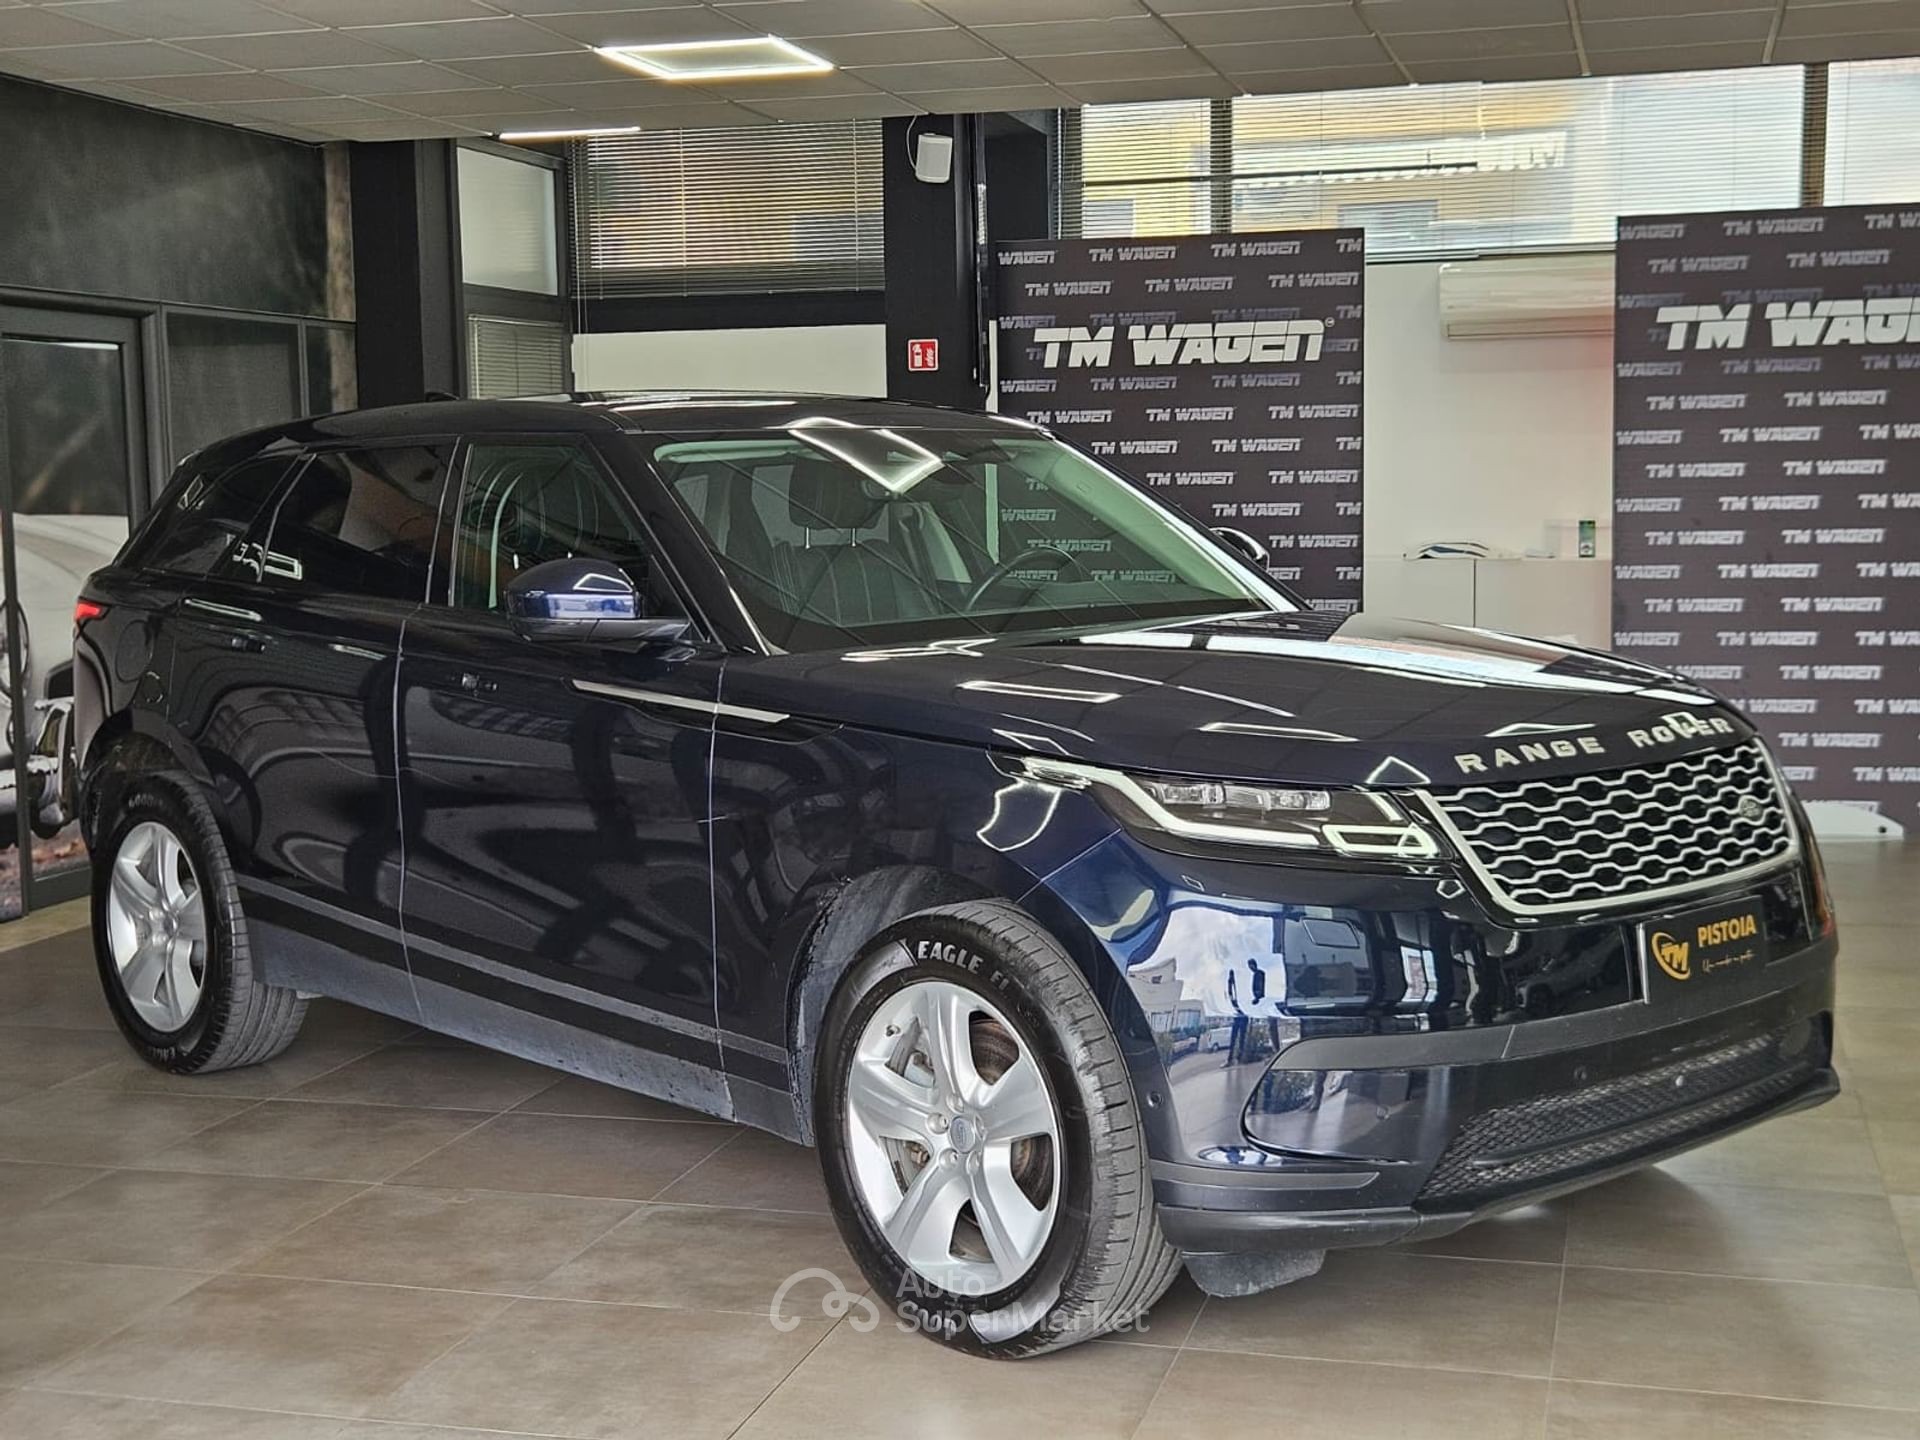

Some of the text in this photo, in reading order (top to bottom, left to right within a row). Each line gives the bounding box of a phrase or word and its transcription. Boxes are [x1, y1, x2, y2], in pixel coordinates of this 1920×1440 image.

[1723, 217, 1824, 236] TM WAGEN
[1865, 214, 1893, 229] TM
[1619, 224, 1684, 240] WAGEN
[1211, 241, 1301, 257] TM WAGEN
[1336, 239, 1362, 252] TM
[999, 250, 1056, 265] WAGEN
[1089, 246, 1177, 262] TM WAGEN
[1787, 250, 1890, 268] TM WAGEN
[1648, 256, 1749, 273] TM WAGEN
[1146, 276, 1234, 292] TM WAGEN
[1268, 272, 1359, 288] TM WAGEN
[1025, 280, 1112, 296] TM WAGEN
[1656, 297, 1920, 350] TM WAG
[1034, 319, 1325, 368] TM WAGEN
[1617, 362, 1682, 377] WAGEN
[1000, 379, 1056, 392] WAGEN
[1336, 372, 1362, 385] TM
[1646, 394, 1746, 410] TM WAGEN
[1784, 390, 1887, 406] TM WAGEN
[1027, 410, 1113, 423] TM WAGEN
[1146, 407, 1234, 422] TM WAGEN
[1268, 404, 1359, 419] TM WAGEN
[1616, 430, 1682, 444] WAGEN
[1719, 426, 1822, 442] TM WAGEN
[1860, 425, 1889, 439] TM
[1092, 440, 1178, 454] TM WAGEN
[1212, 438, 1301, 452] TM WAGEN
[1336, 437, 1362, 450] TM
[1646, 462, 1745, 478] TM WAGEN
[1783, 460, 1885, 476] TM WAGEN
[1147, 472, 1234, 485] TM WAGEN
[1268, 470, 1359, 483] TM WAGEN
[1616, 497, 1682, 512] WAGEN
[1719, 495, 1821, 511] TM WAGEN
[1858, 494, 1888, 508] TM
[1213, 503, 1301, 517] TM WAGEN
[1336, 502, 1362, 515] TM
[1269, 534, 1359, 548] TM WAGEN
[1645, 530, 1744, 545] TM WAGEN
[1782, 529, 1884, 544] TM WAGEN
[1336, 567, 1361, 580] TM
[1615, 565, 1681, 579] WAGEN
[1718, 564, 1820, 578] TM WAGEN
[1857, 563, 1887, 577] TM
[1645, 598, 1743, 612] TM WAGEN
[1781, 598, 1883, 611] TM WAGEN
[1615, 632, 1680, 646] WAGEN
[1717, 632, 1818, 645] TM WAGEN
[1855, 632, 1885, 645] TM
[1780, 665, 1883, 679] TM WAGEN
[1749, 699, 1817, 713] WAGEN
[1854, 700, 1884, 713] TM
[1454, 716, 1734, 774] RANGE ROVER
[1779, 733, 1882, 747] TM WAGEN
[1697, 914, 1757, 947] PISTOIA
[918, 940, 983, 974] EAGLE
